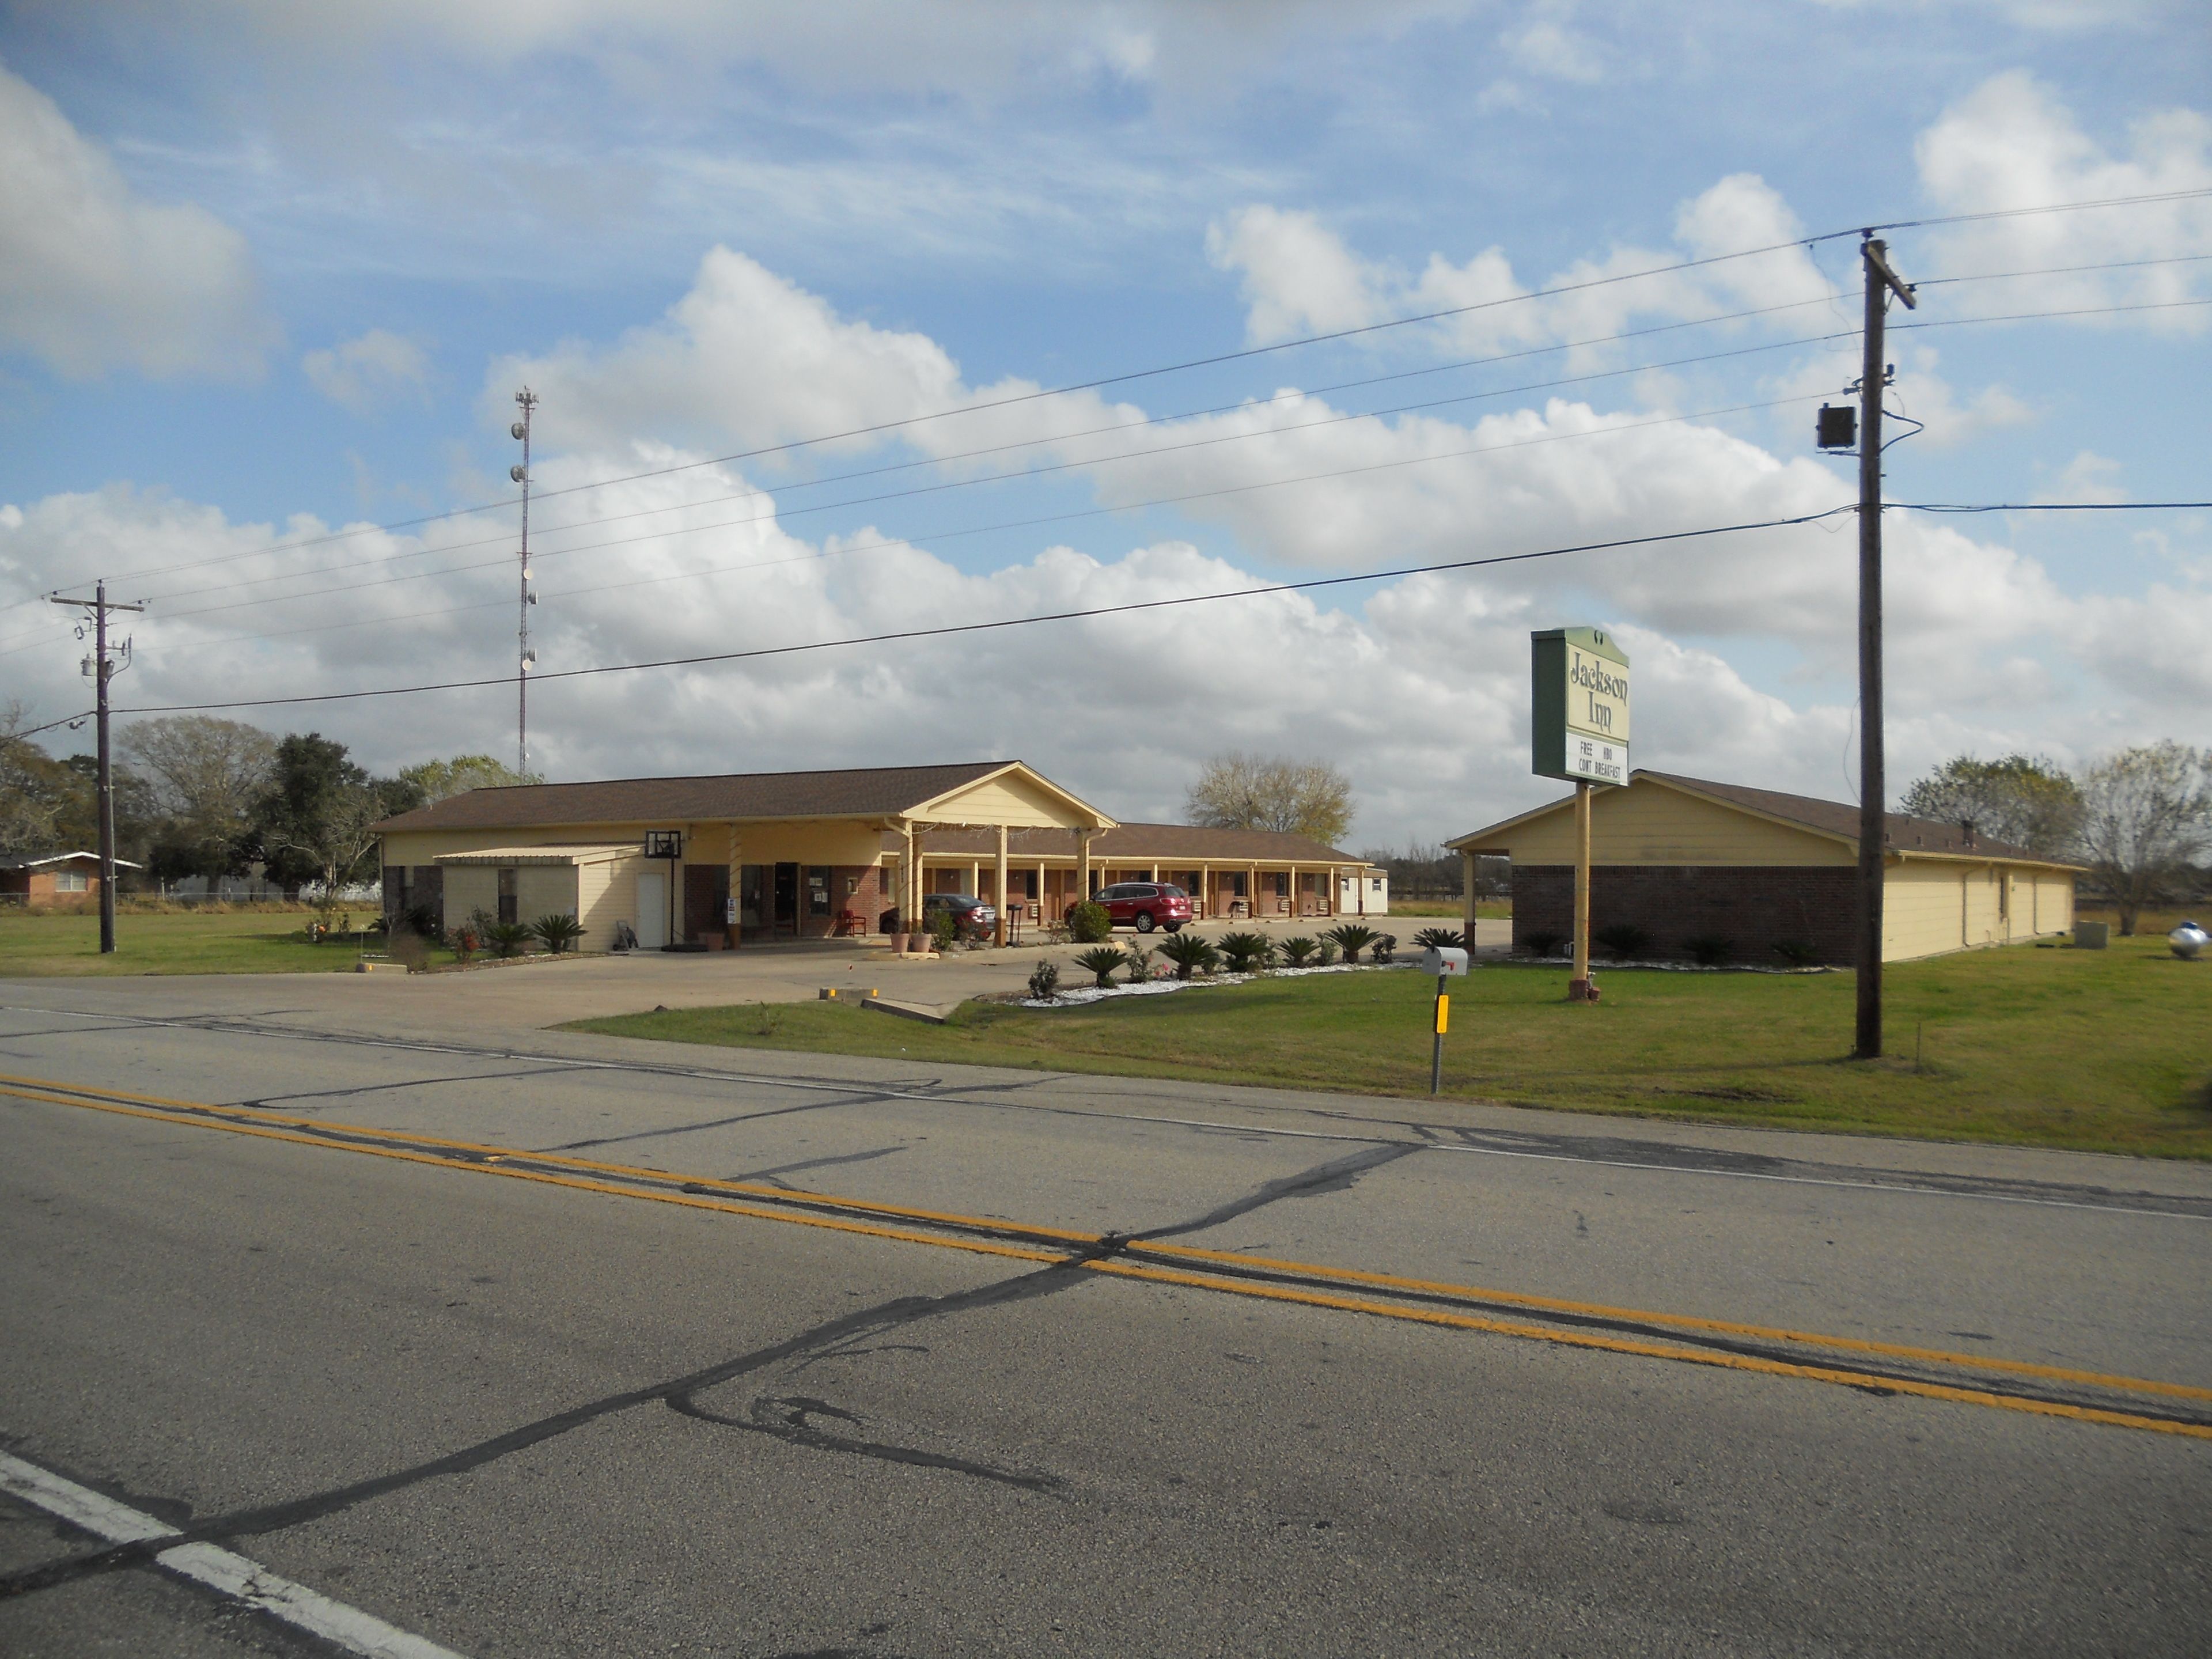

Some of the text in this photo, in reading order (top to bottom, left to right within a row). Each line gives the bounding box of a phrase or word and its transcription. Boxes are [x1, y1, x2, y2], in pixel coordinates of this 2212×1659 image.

[1570, 652, 1628, 706] Jackson
[1588, 691, 1611, 734] Inn
[1581, 741, 1612, 760] FREE HBO
[1595, 762, 1620, 779] BREAKFAST
